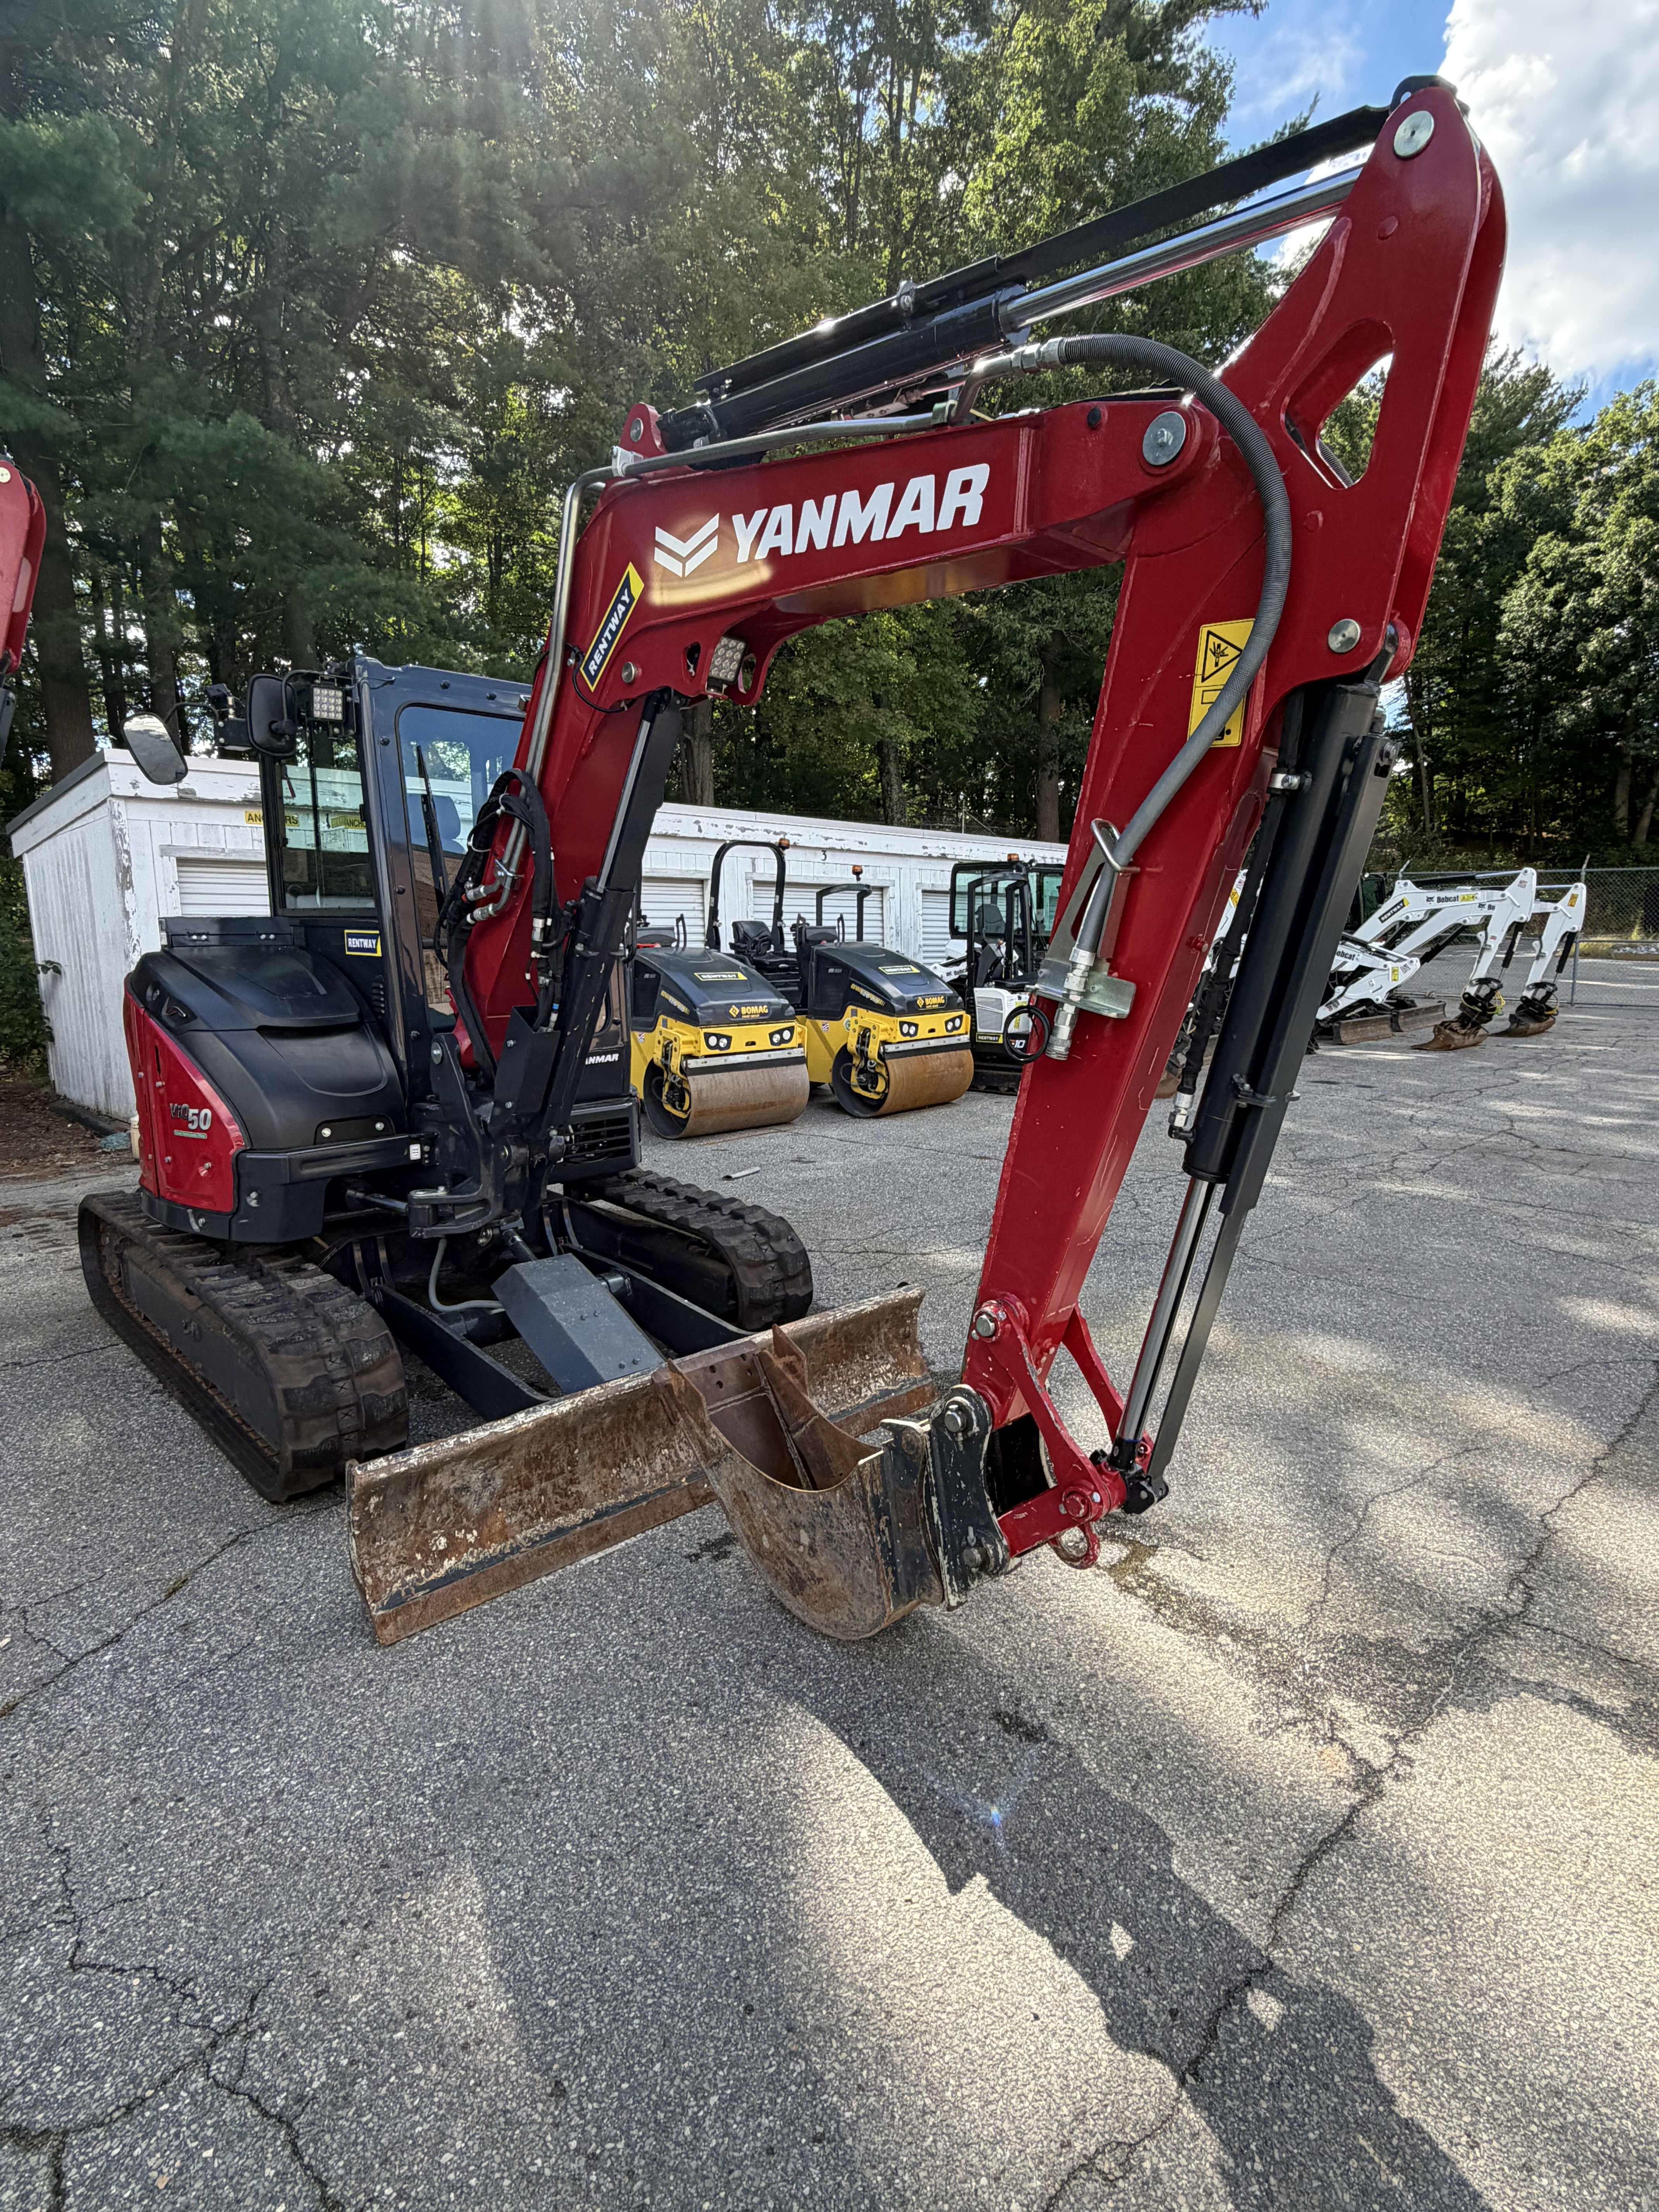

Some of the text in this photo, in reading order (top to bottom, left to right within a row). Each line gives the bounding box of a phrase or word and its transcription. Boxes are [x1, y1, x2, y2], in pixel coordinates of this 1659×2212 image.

[732, 463, 990, 563] YANMAR
[588, 588, 630, 676] RENTWAY
[821, 849, 827, 861] 3
[1437, 895, 1459, 903] Bobcat
[347, 938, 376, 949] RENTWAY
[1336, 950, 1355, 961] obcat
[925, 996, 945, 1005] BOMAG
[740, 1005, 768, 1015] BOMAG
